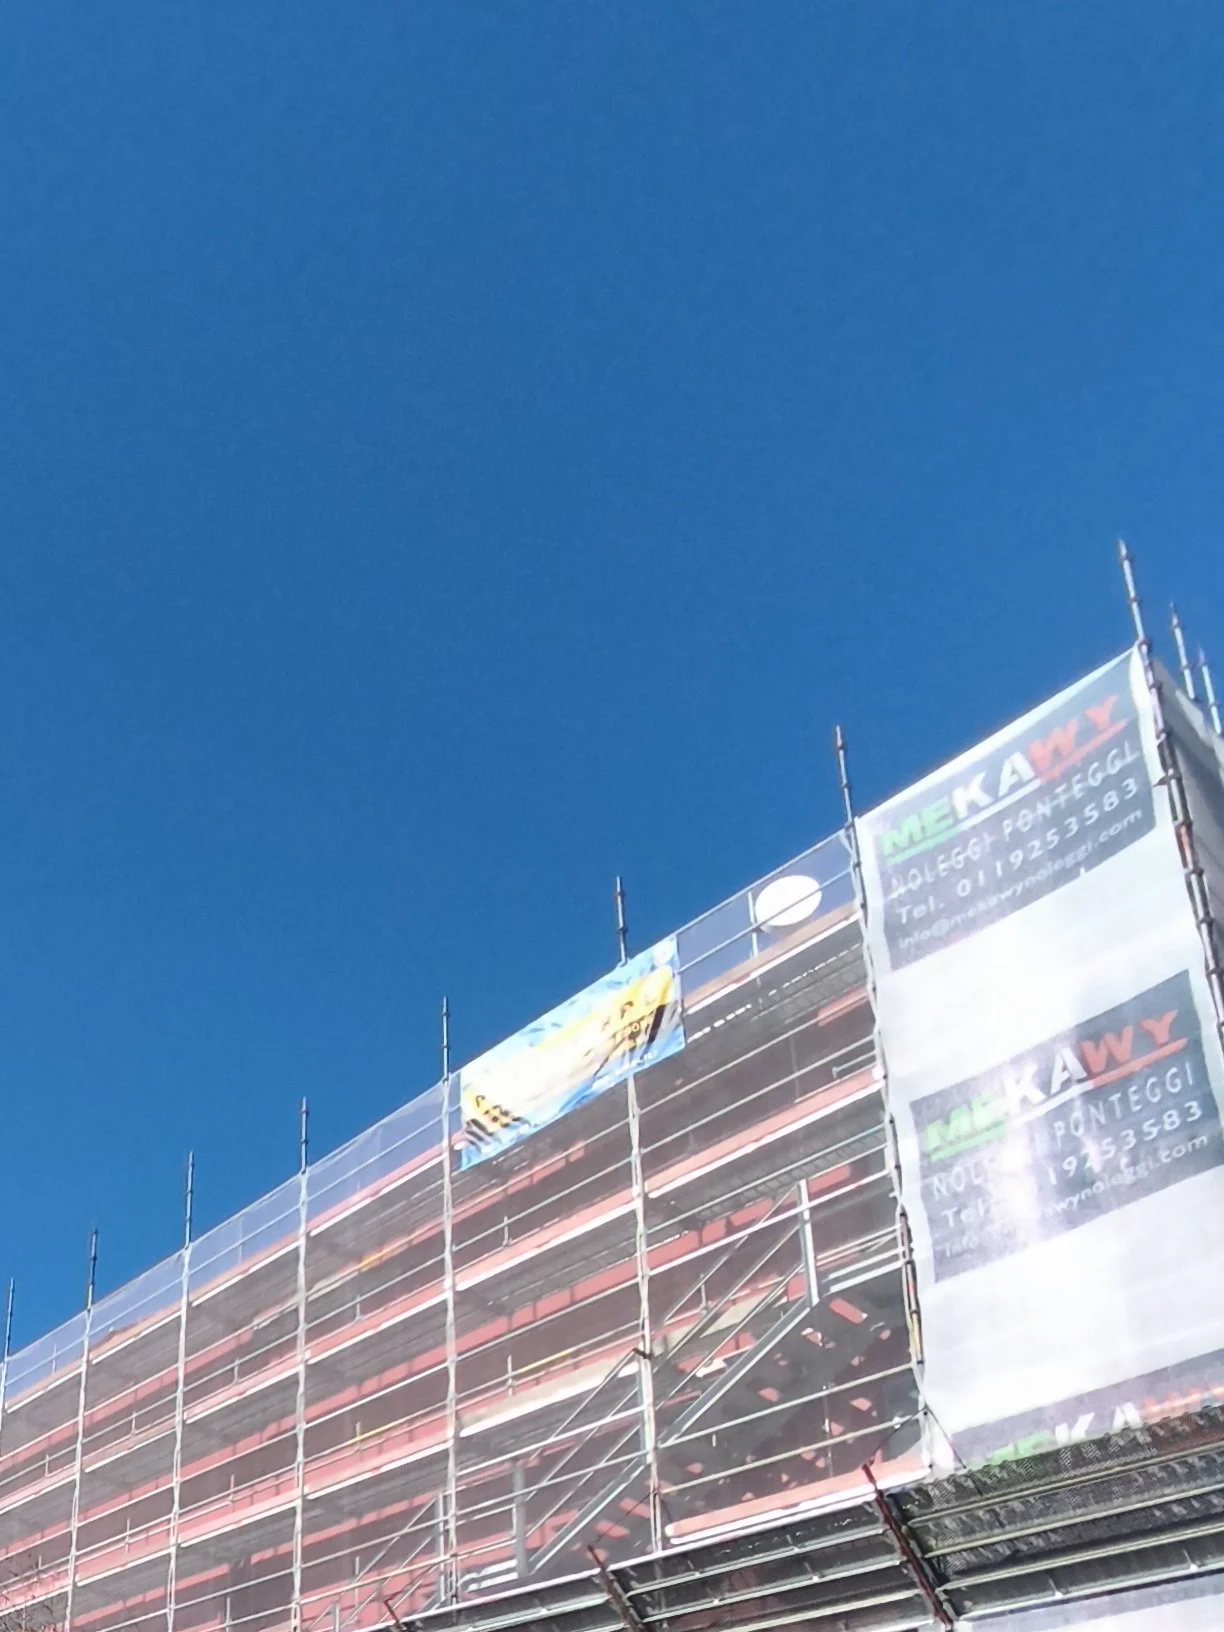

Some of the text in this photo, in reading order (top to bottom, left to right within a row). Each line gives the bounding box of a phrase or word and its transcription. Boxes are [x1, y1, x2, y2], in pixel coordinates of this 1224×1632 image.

[880, 695, 1120, 856] MEKAWY
[891, 741, 1135, 897] NOLEGGI PONTEGGI
[925, 1009, 1178, 1147] MEKAWY
[1053, 1061, 1194, 1148] PONTEGGI
